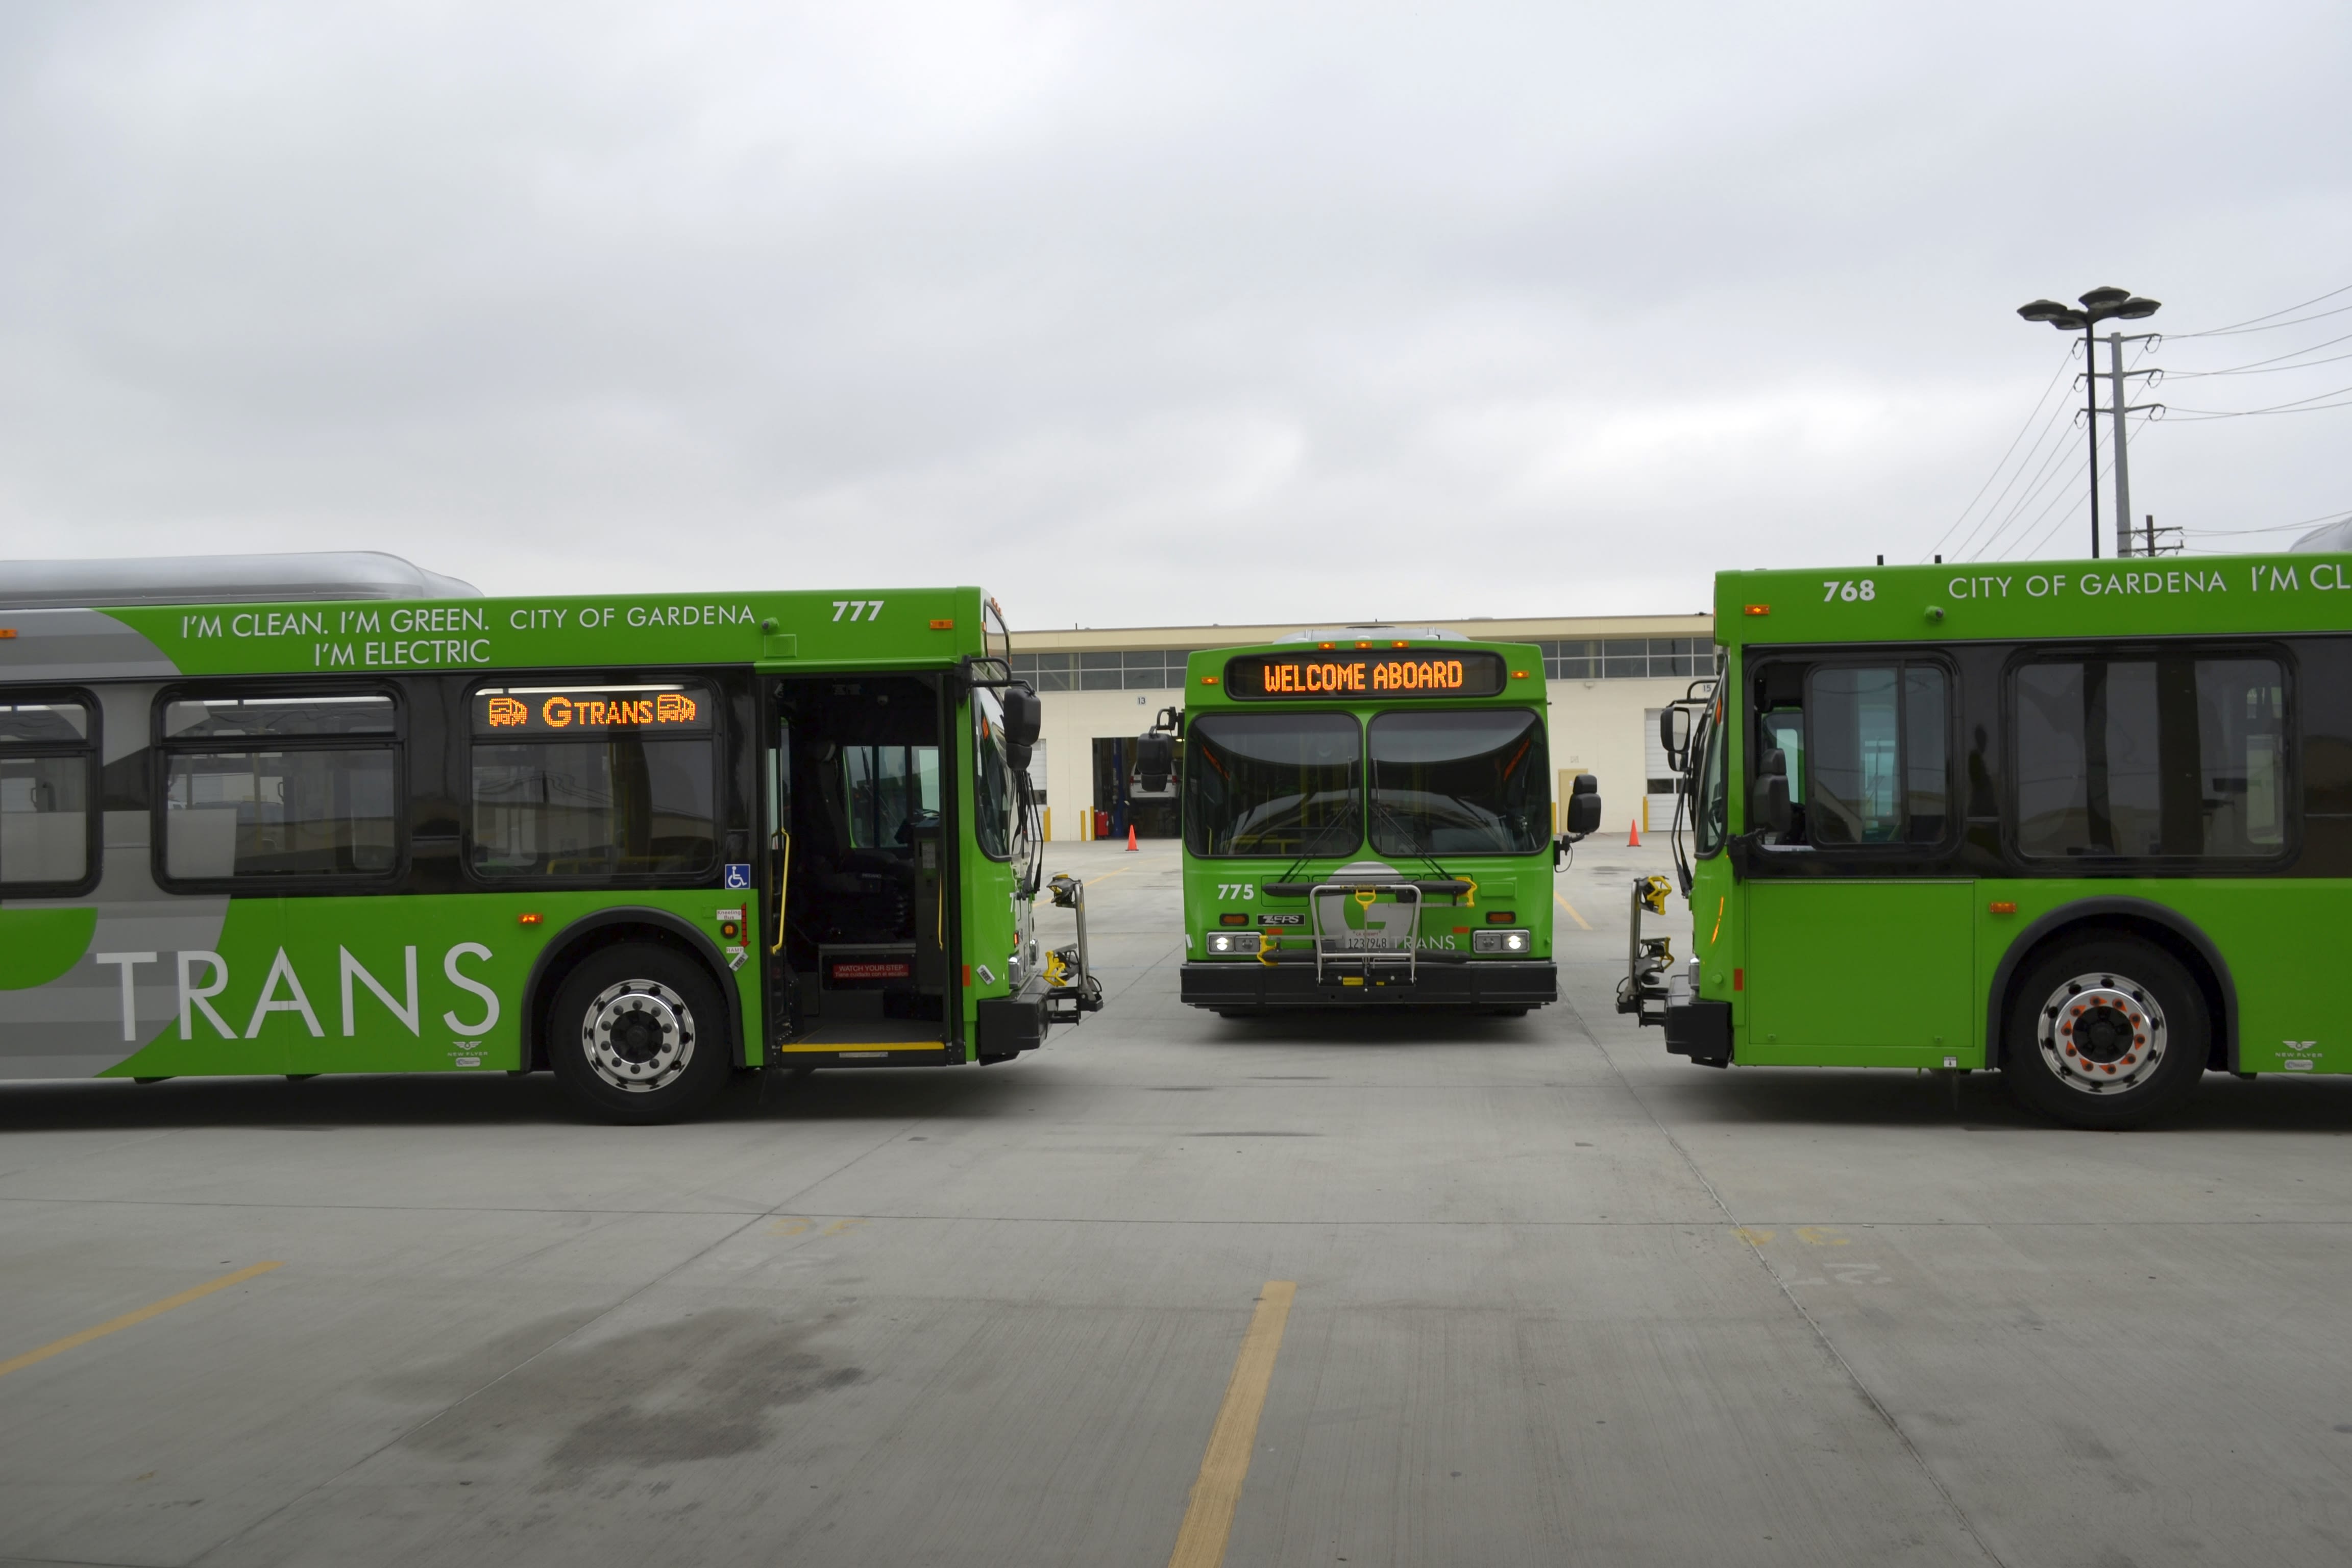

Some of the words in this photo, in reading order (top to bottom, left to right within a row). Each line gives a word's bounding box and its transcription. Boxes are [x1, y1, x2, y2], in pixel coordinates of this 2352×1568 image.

[1949, 576, 2012, 599] CITY
[2026, 575, 2066, 597] OF
[2080, 571, 2226, 595] GARDENA
[2251, 565, 2298, 591] I'M
[2310, 564, 2351, 590] CL
[1823, 579, 1875, 602] 768
[183, 615, 222, 638] I'M
[232, 612, 328, 637] CLEAN.
[341, 611, 380, 633] I'M
[390, 608, 489, 633] GREEN.
[510, 609, 567, 629] CITY
[579, 608, 615, 628] OF
[627, 605, 755, 627] GARDENA
[832, 600, 885, 622] 777
[315, 643, 355, 666] I'M
[365, 639, 490, 665] ELECTRIC
[1264, 663, 1365, 692] WELCOME
[1373, 660, 1462, 690] ABOARD
[1703, 684, 1712, 692] 15
[1138, 697, 1146, 705] 13
[1218, 884, 1254, 900] 775
[1391, 935, 1456, 950] TRANS
[96, 942, 500, 1041] TRANS
